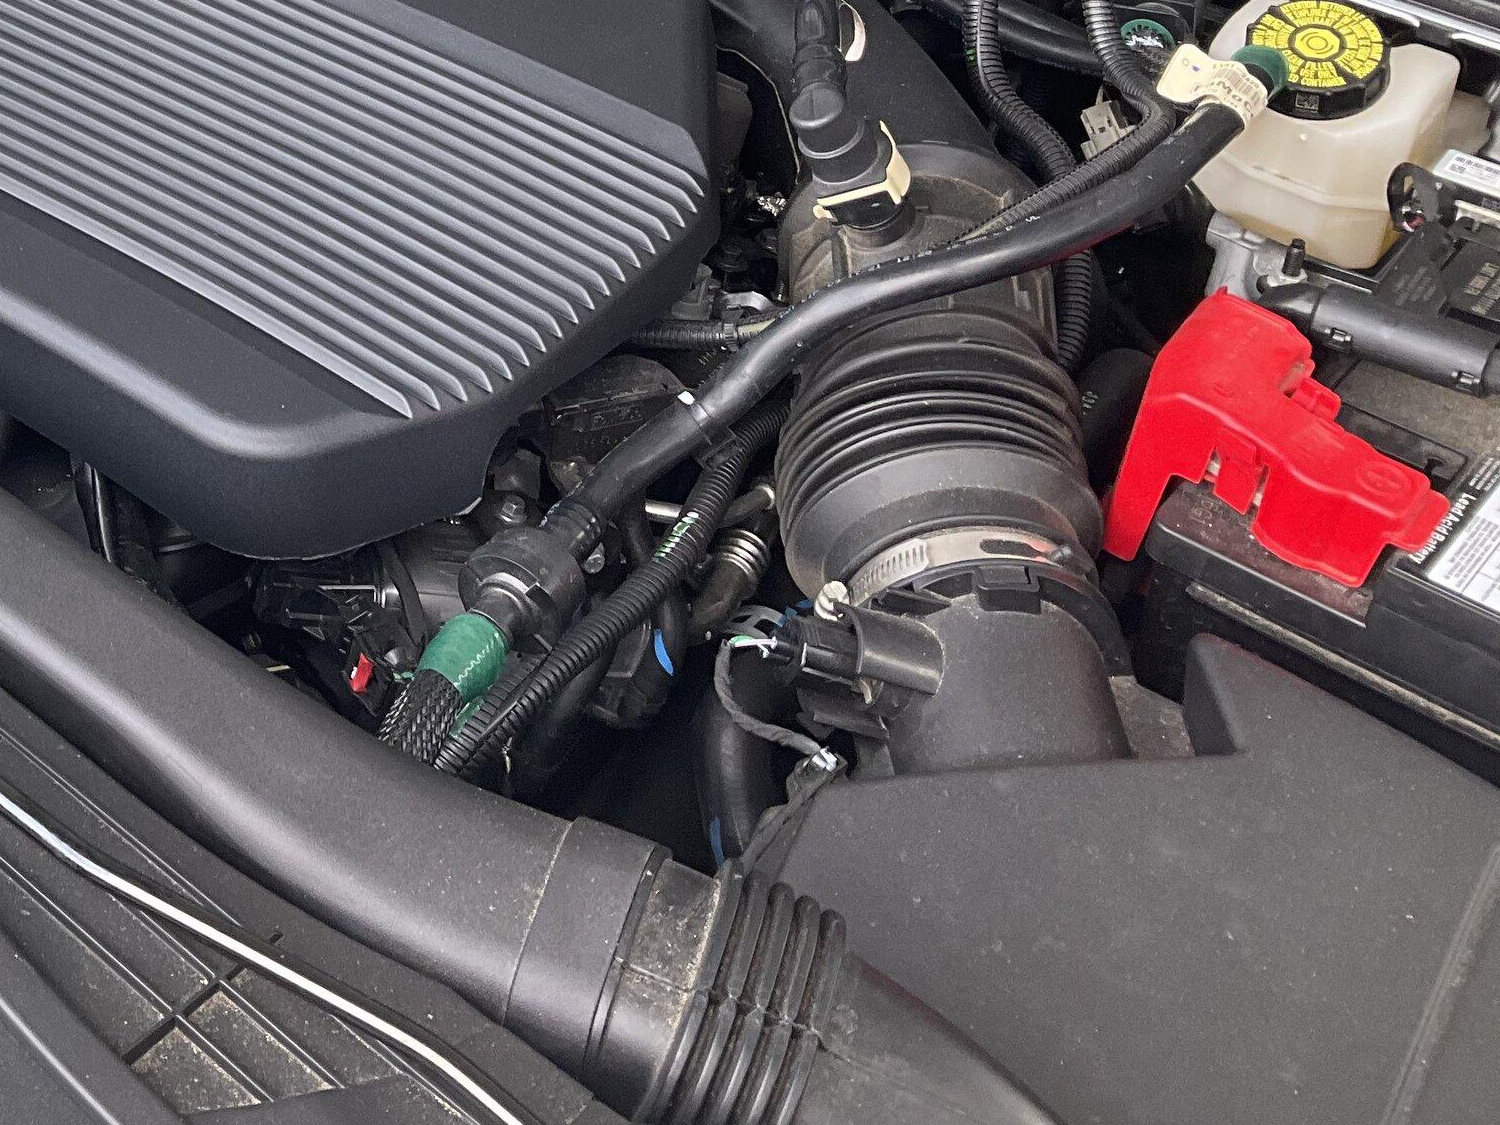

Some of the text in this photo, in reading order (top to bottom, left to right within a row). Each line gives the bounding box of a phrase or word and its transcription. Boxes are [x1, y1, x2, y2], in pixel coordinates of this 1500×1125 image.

[1300, 68, 1315, 78] USE
[1300, 76, 1347, 87] CONTAINER
[1450, 492, 1477, 518] Lead
[1410, 530, 1447, 564] Battery
